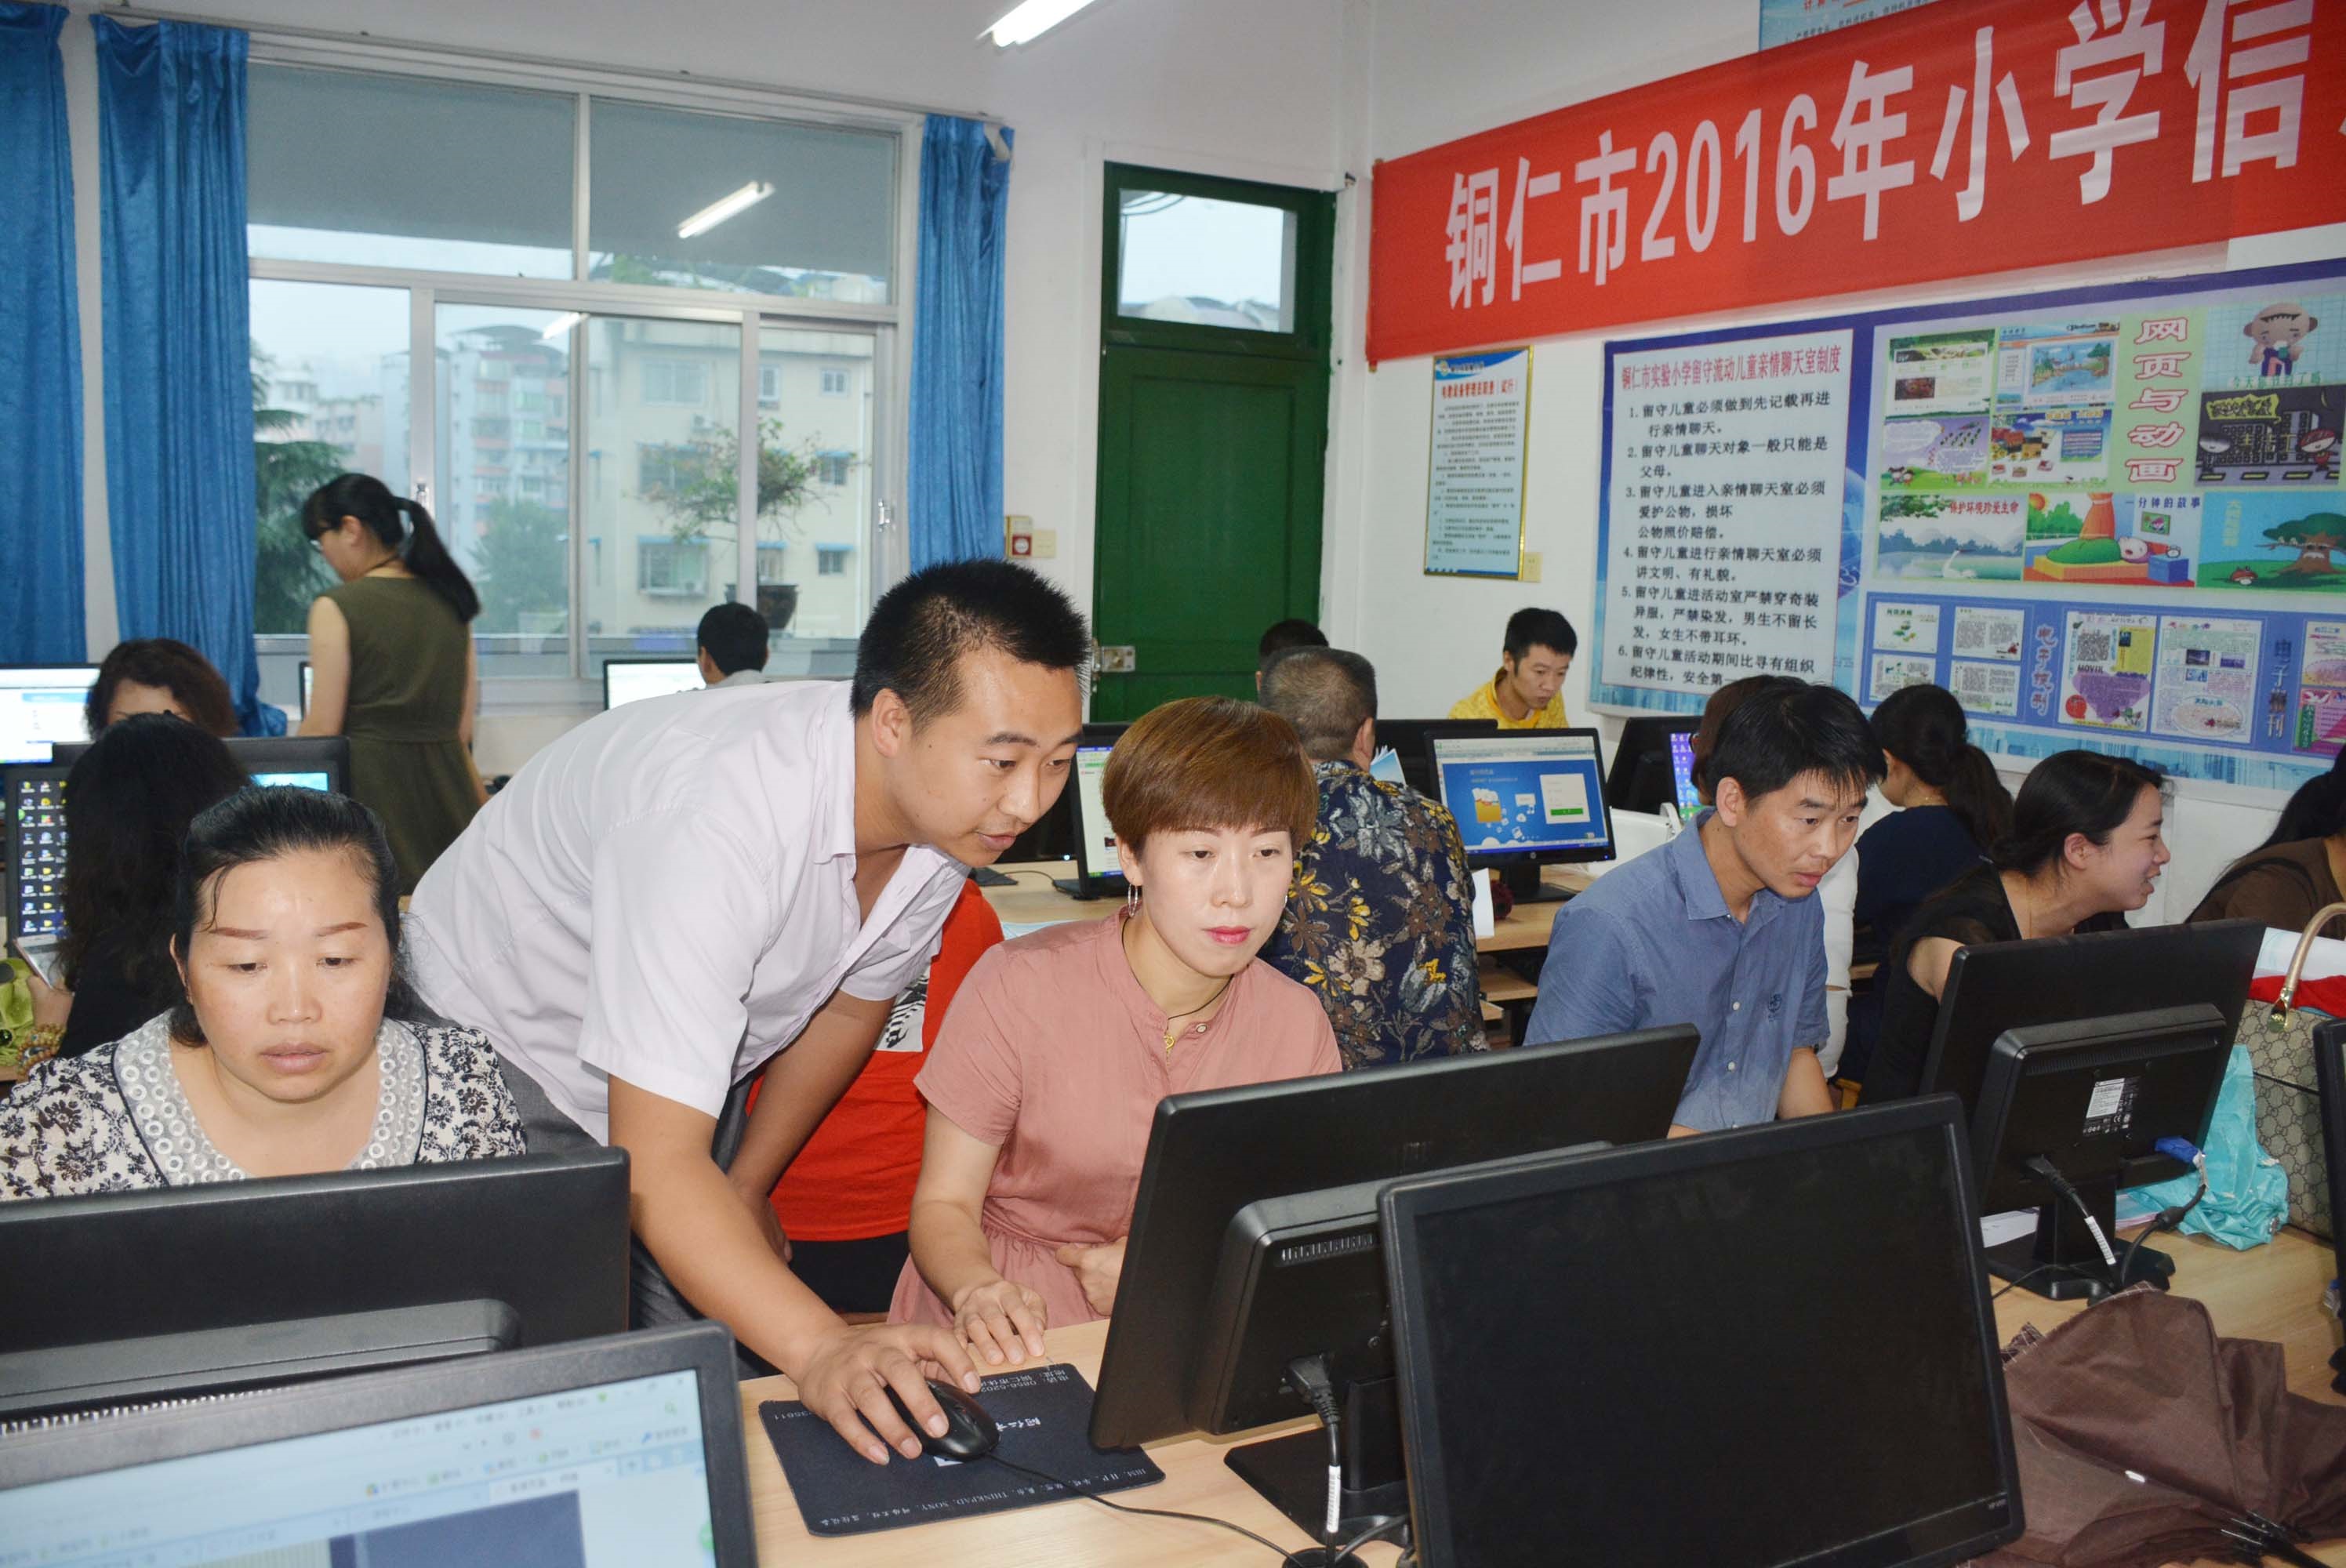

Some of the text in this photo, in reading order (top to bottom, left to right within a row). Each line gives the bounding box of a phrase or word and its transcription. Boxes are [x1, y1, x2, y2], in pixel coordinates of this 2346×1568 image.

[1445, 0, 2346, 310] 铜仁市2016年小学信
[2125, 317, 2192, 483] 网页与动画
[2126, 496, 2201, 509] 一分钟的故事
